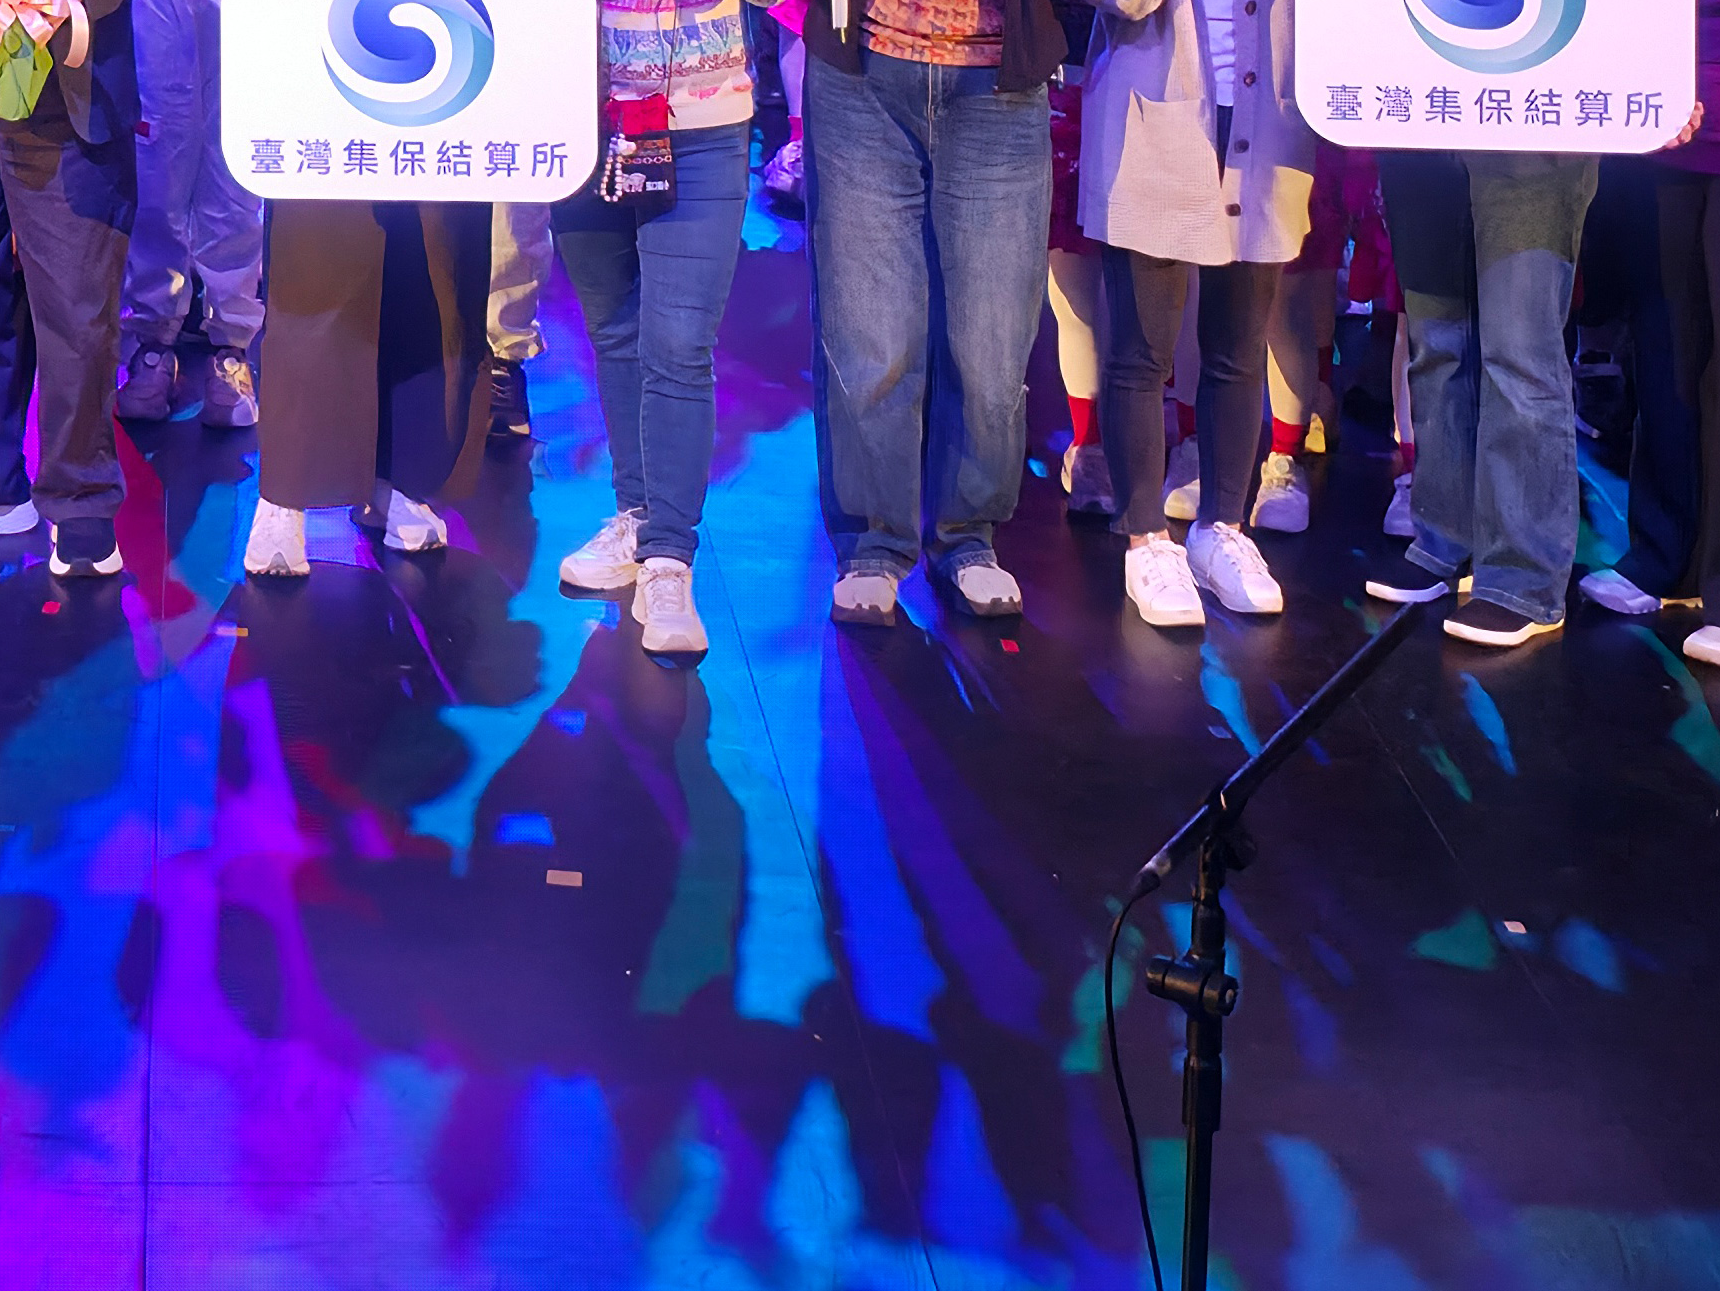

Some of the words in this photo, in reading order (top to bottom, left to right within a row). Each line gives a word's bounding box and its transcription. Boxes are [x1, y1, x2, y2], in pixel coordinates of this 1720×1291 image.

[1325, 83, 1665, 129] 臺灣集保結算所
[249, 138, 569, 179] 臺灣集保結算所
